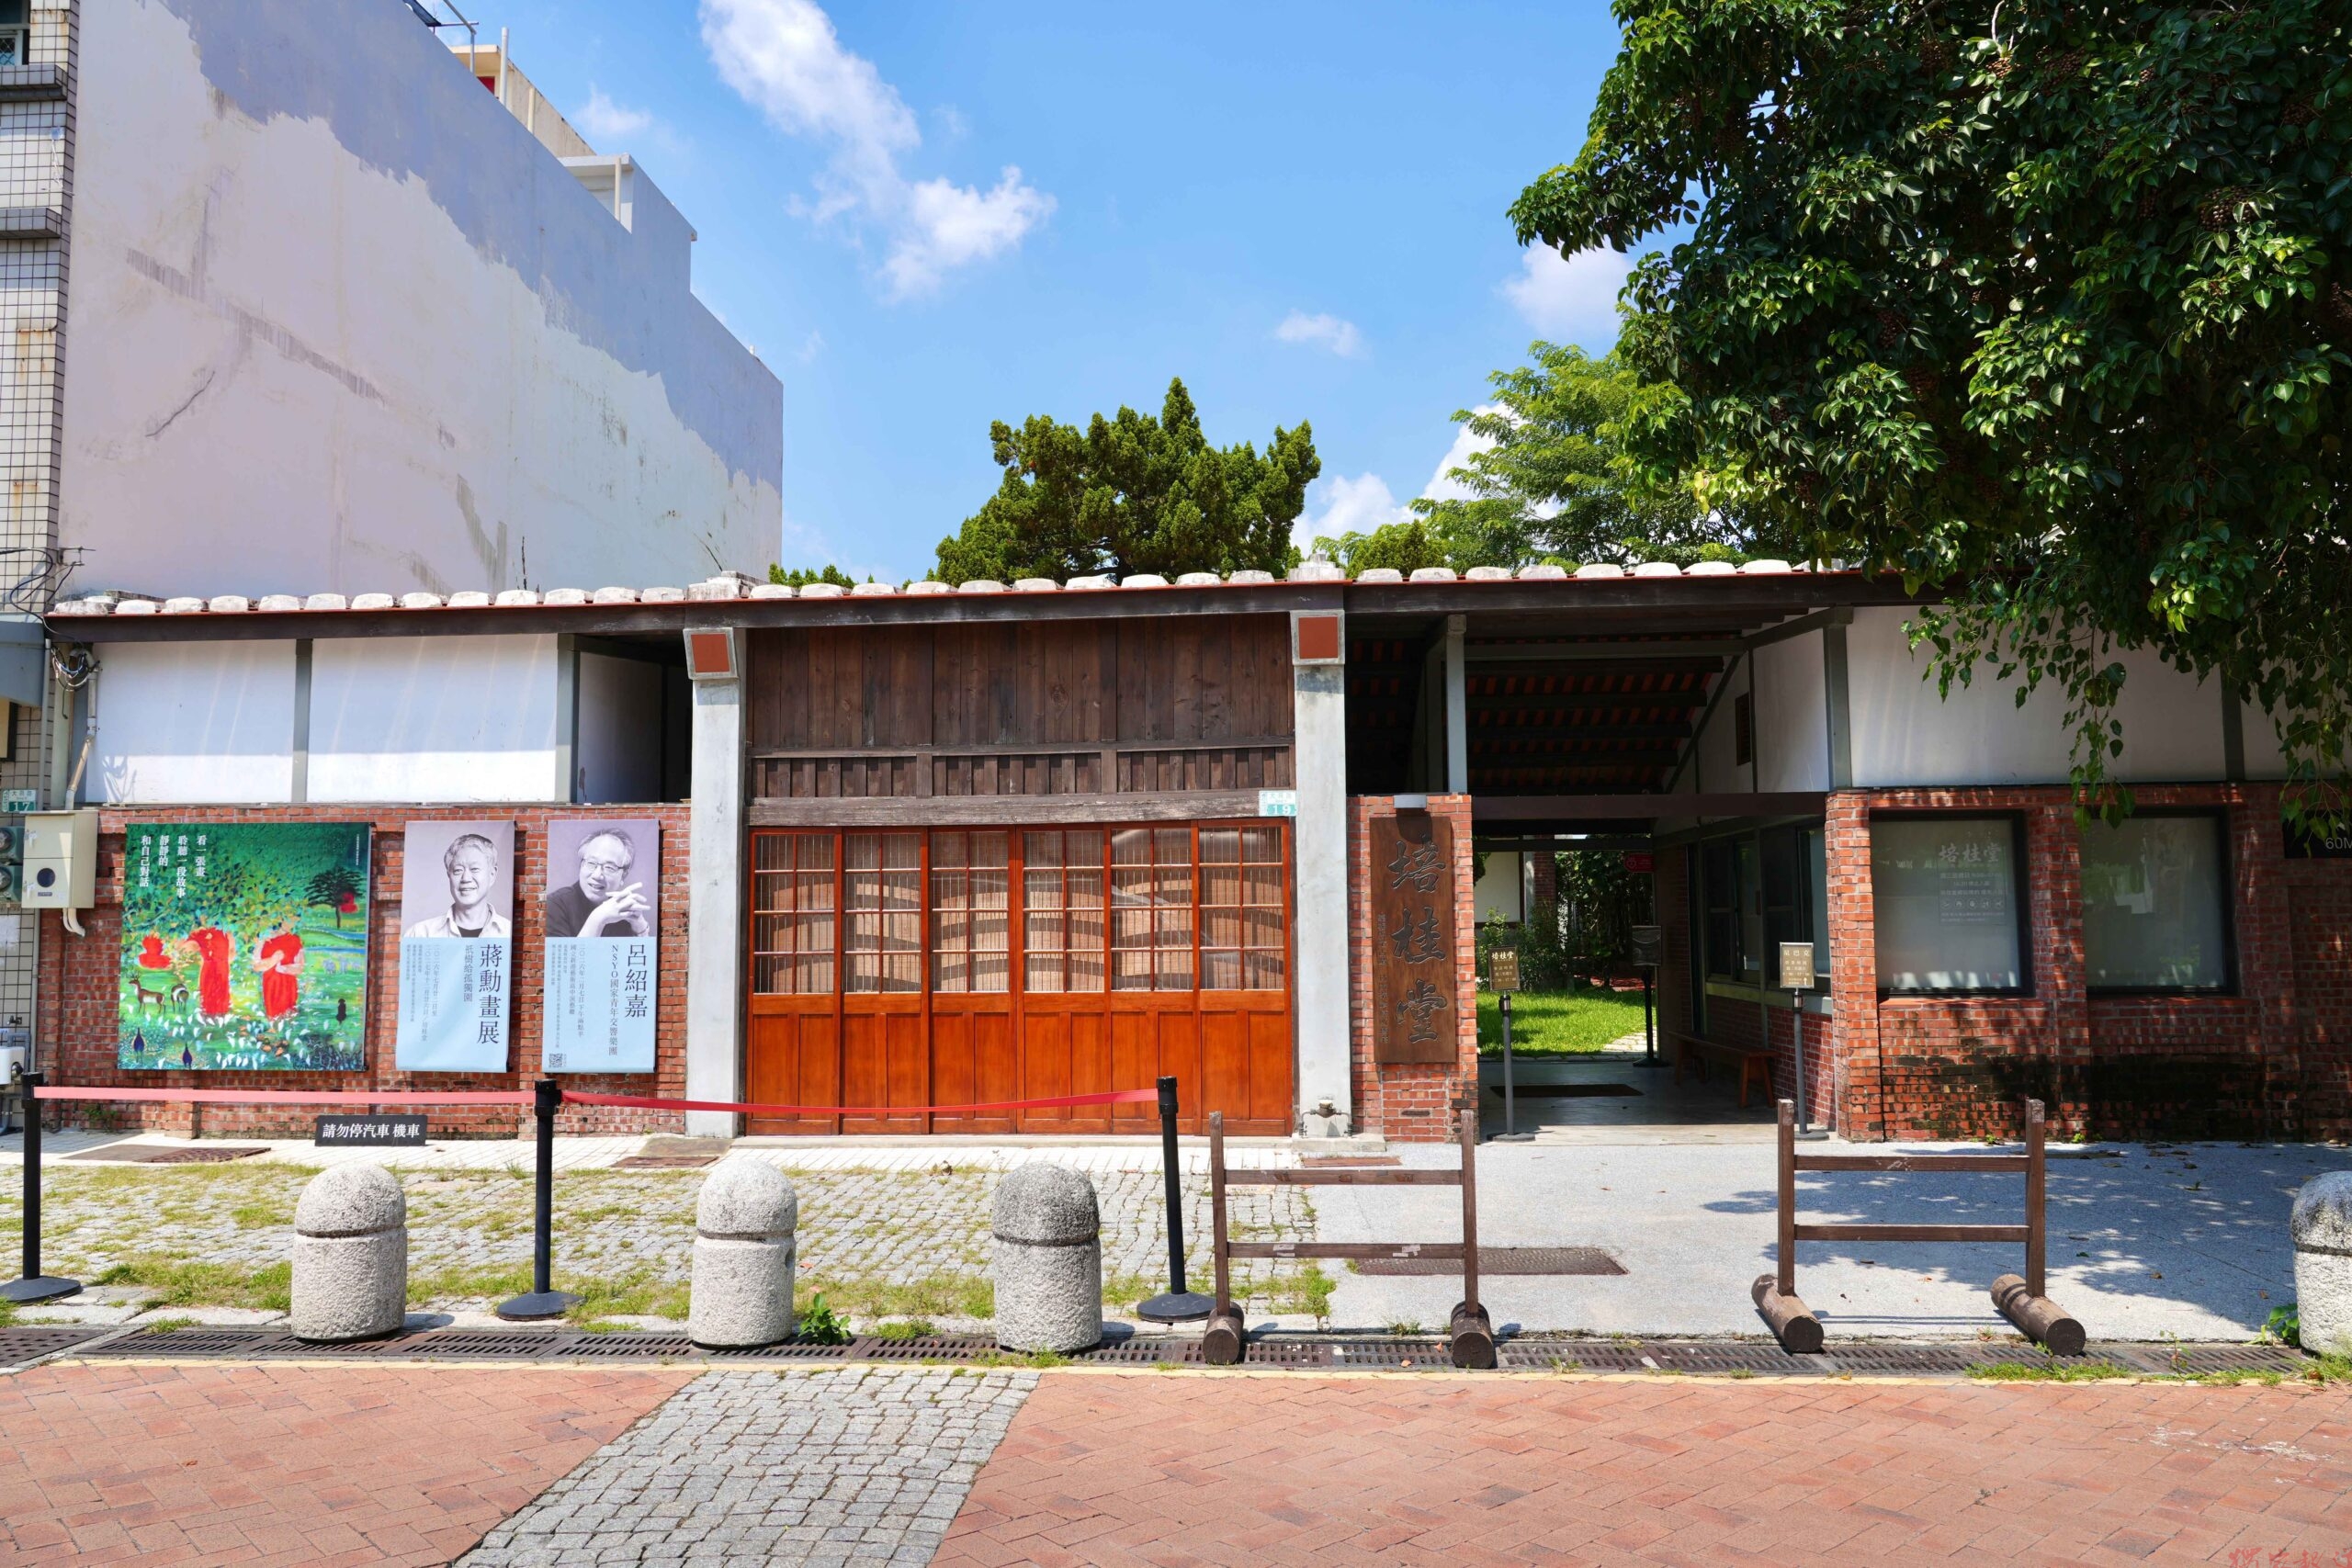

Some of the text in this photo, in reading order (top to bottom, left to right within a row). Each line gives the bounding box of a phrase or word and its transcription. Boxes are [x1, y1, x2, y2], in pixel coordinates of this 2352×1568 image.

[14, 801, 30, 811] 17
[1272, 805, 1291, 815] 19
[139, 834, 152, 887] 和自己對話
[158, 834, 170, 867] 靜靜的
[175, 834, 188, 898] 聆聽一段故事
[195, 834, 208, 877] 看一張畫
[1939, 842, 2002, 863] 培桂堂
[1385, 832, 1448, 1044] 培桂堂
[1491, 951, 1514, 960] 培桂堂
[477, 943, 503, 1044] 蔣勳畫展
[624, 943, 648, 1018] 呂紹嘉
[322, 1122, 421, 1138] 請勿停汽車 機車
